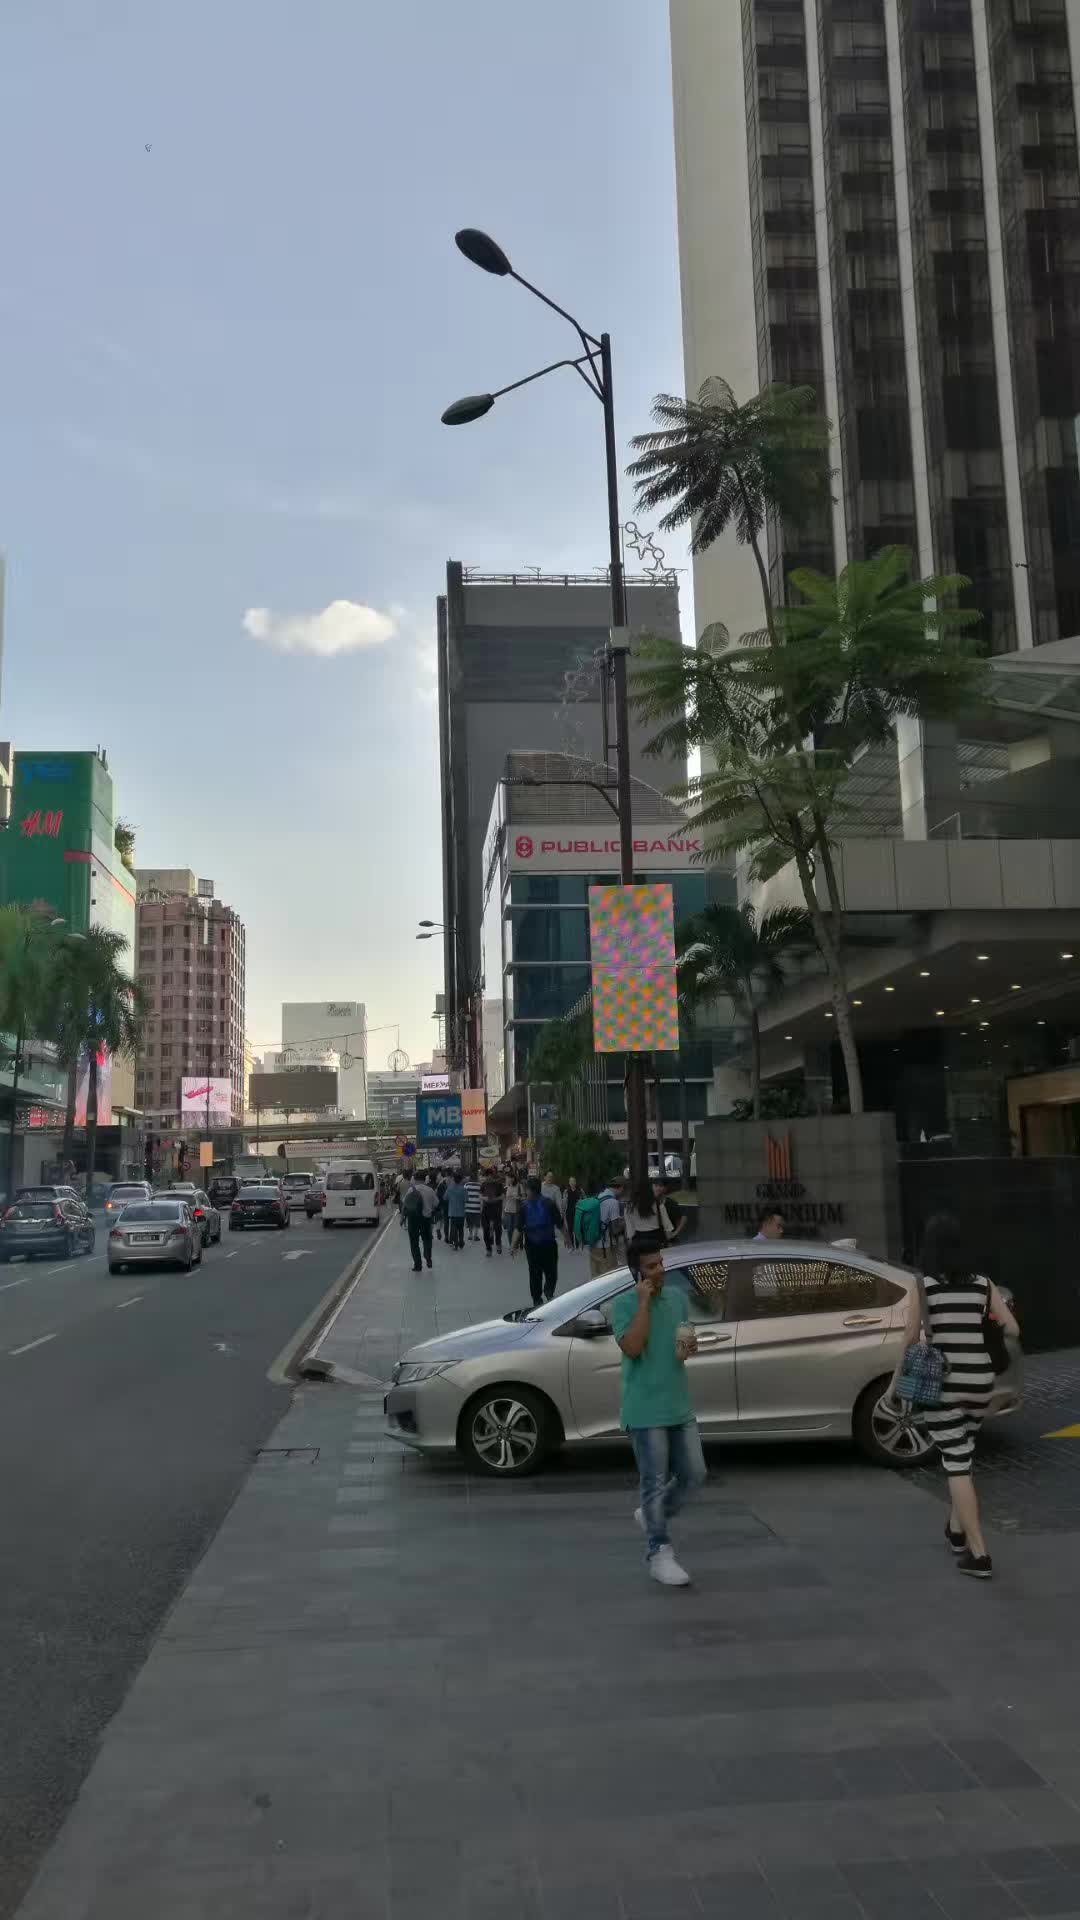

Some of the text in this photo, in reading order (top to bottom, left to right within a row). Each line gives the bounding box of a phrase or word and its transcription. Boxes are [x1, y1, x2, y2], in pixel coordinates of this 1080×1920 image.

[541, 839, 700, 853] PUBLIC BANK
[724, 1203, 844, 1224] MILLNNIUM
